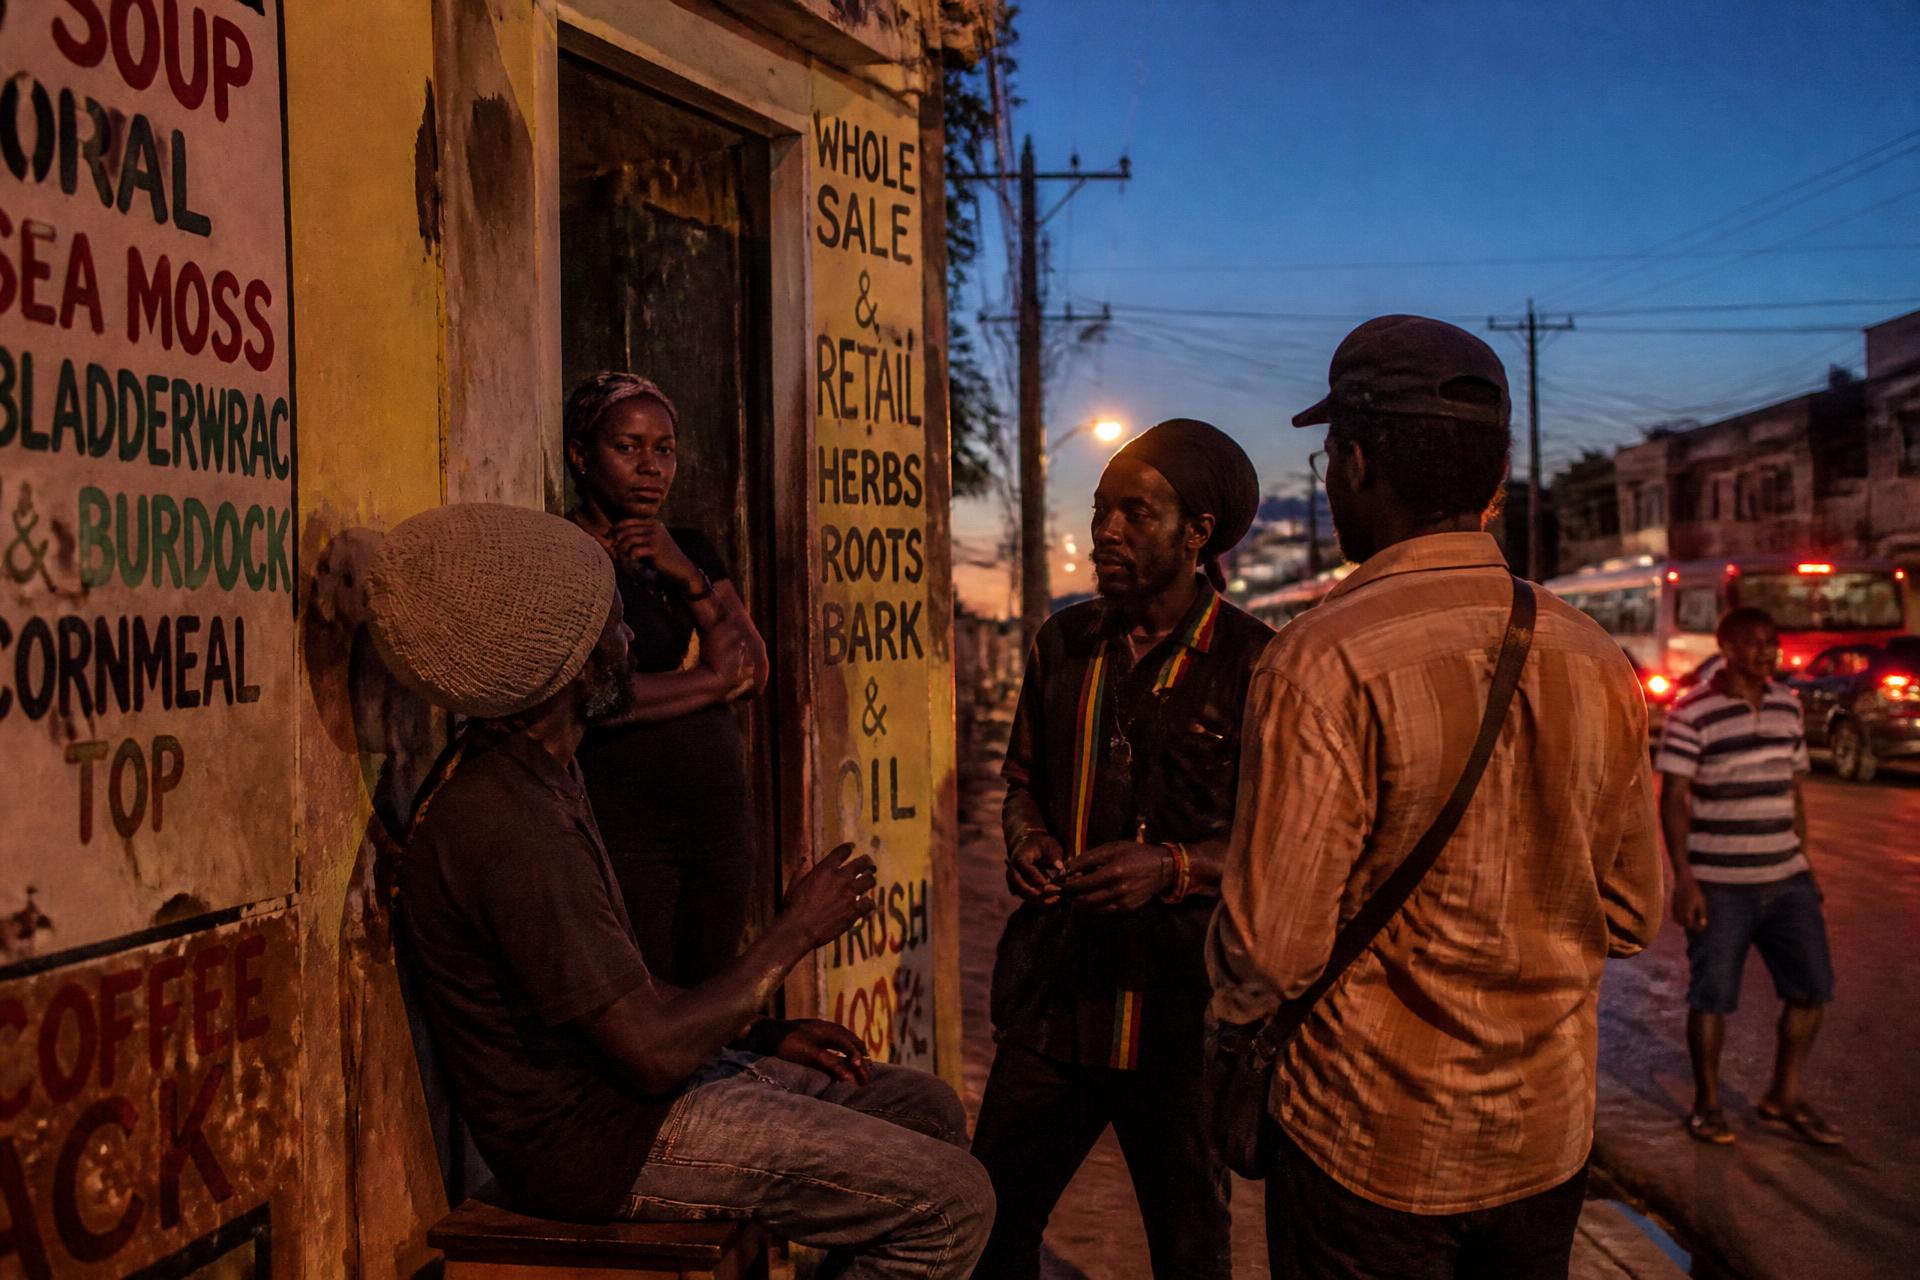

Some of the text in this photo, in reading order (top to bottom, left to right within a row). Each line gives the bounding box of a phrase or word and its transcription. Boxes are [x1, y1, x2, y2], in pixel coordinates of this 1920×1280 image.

[52, 0, 253, 123] SOUP
[813, 109, 916, 195] WHOLE
[816, 184, 913, 265] SALE
[126, 245, 275, 373] MOSS
[855, 269, 881, 336] &
[816, 333, 921, 427] RETAIL
[818, 446, 923, 508] HERBS
[78, 486, 292, 594] BURDOCK
[820, 524, 924, 584] ROOTS
[822, 600, 924, 666] BARK
[861, 676, 888, 737] &
[64, 734, 185, 846] TOP
[836, 756, 916, 830] OIL
